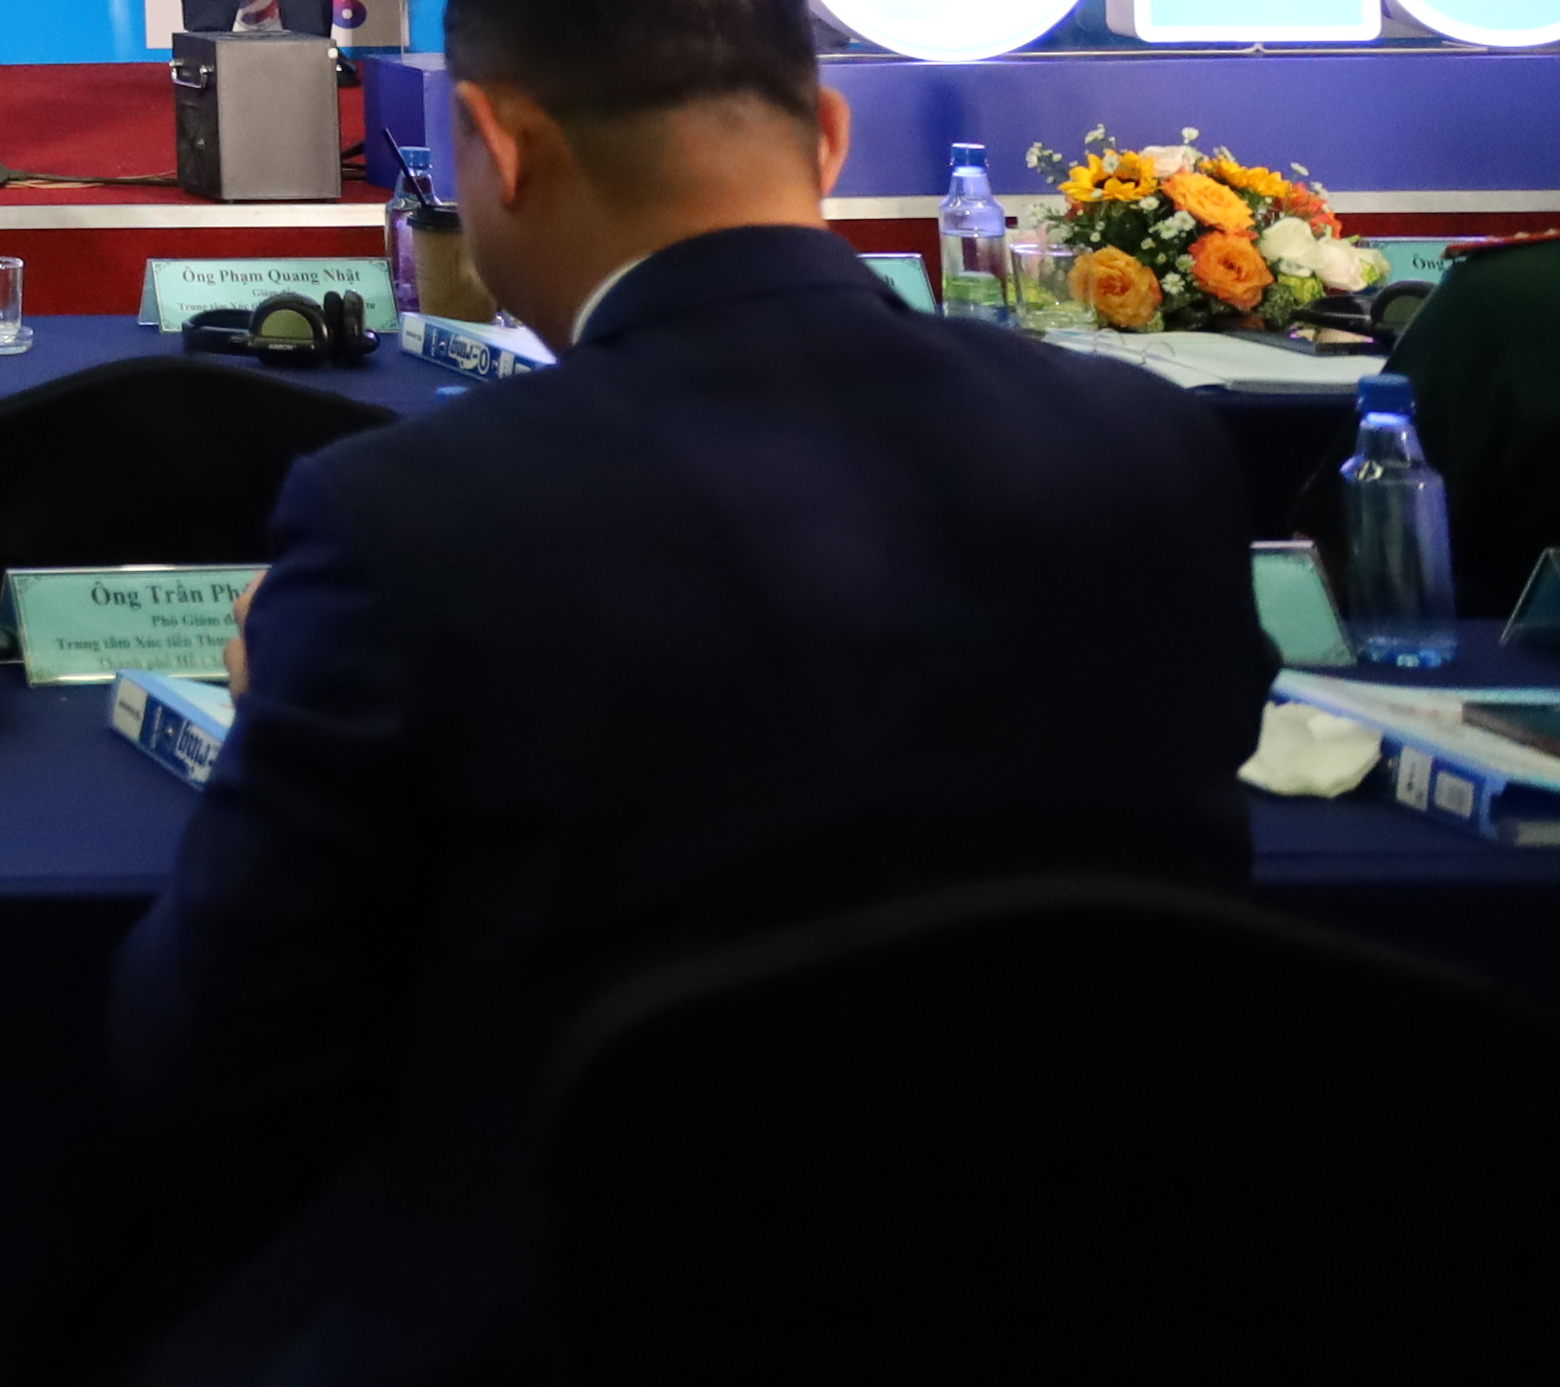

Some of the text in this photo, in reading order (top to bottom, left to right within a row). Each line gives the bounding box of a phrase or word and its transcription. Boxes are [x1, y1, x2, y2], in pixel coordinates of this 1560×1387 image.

[183, 266, 361, 286] Ông Phạm Quang Nhật
[90, 579, 143, 609] Ông
